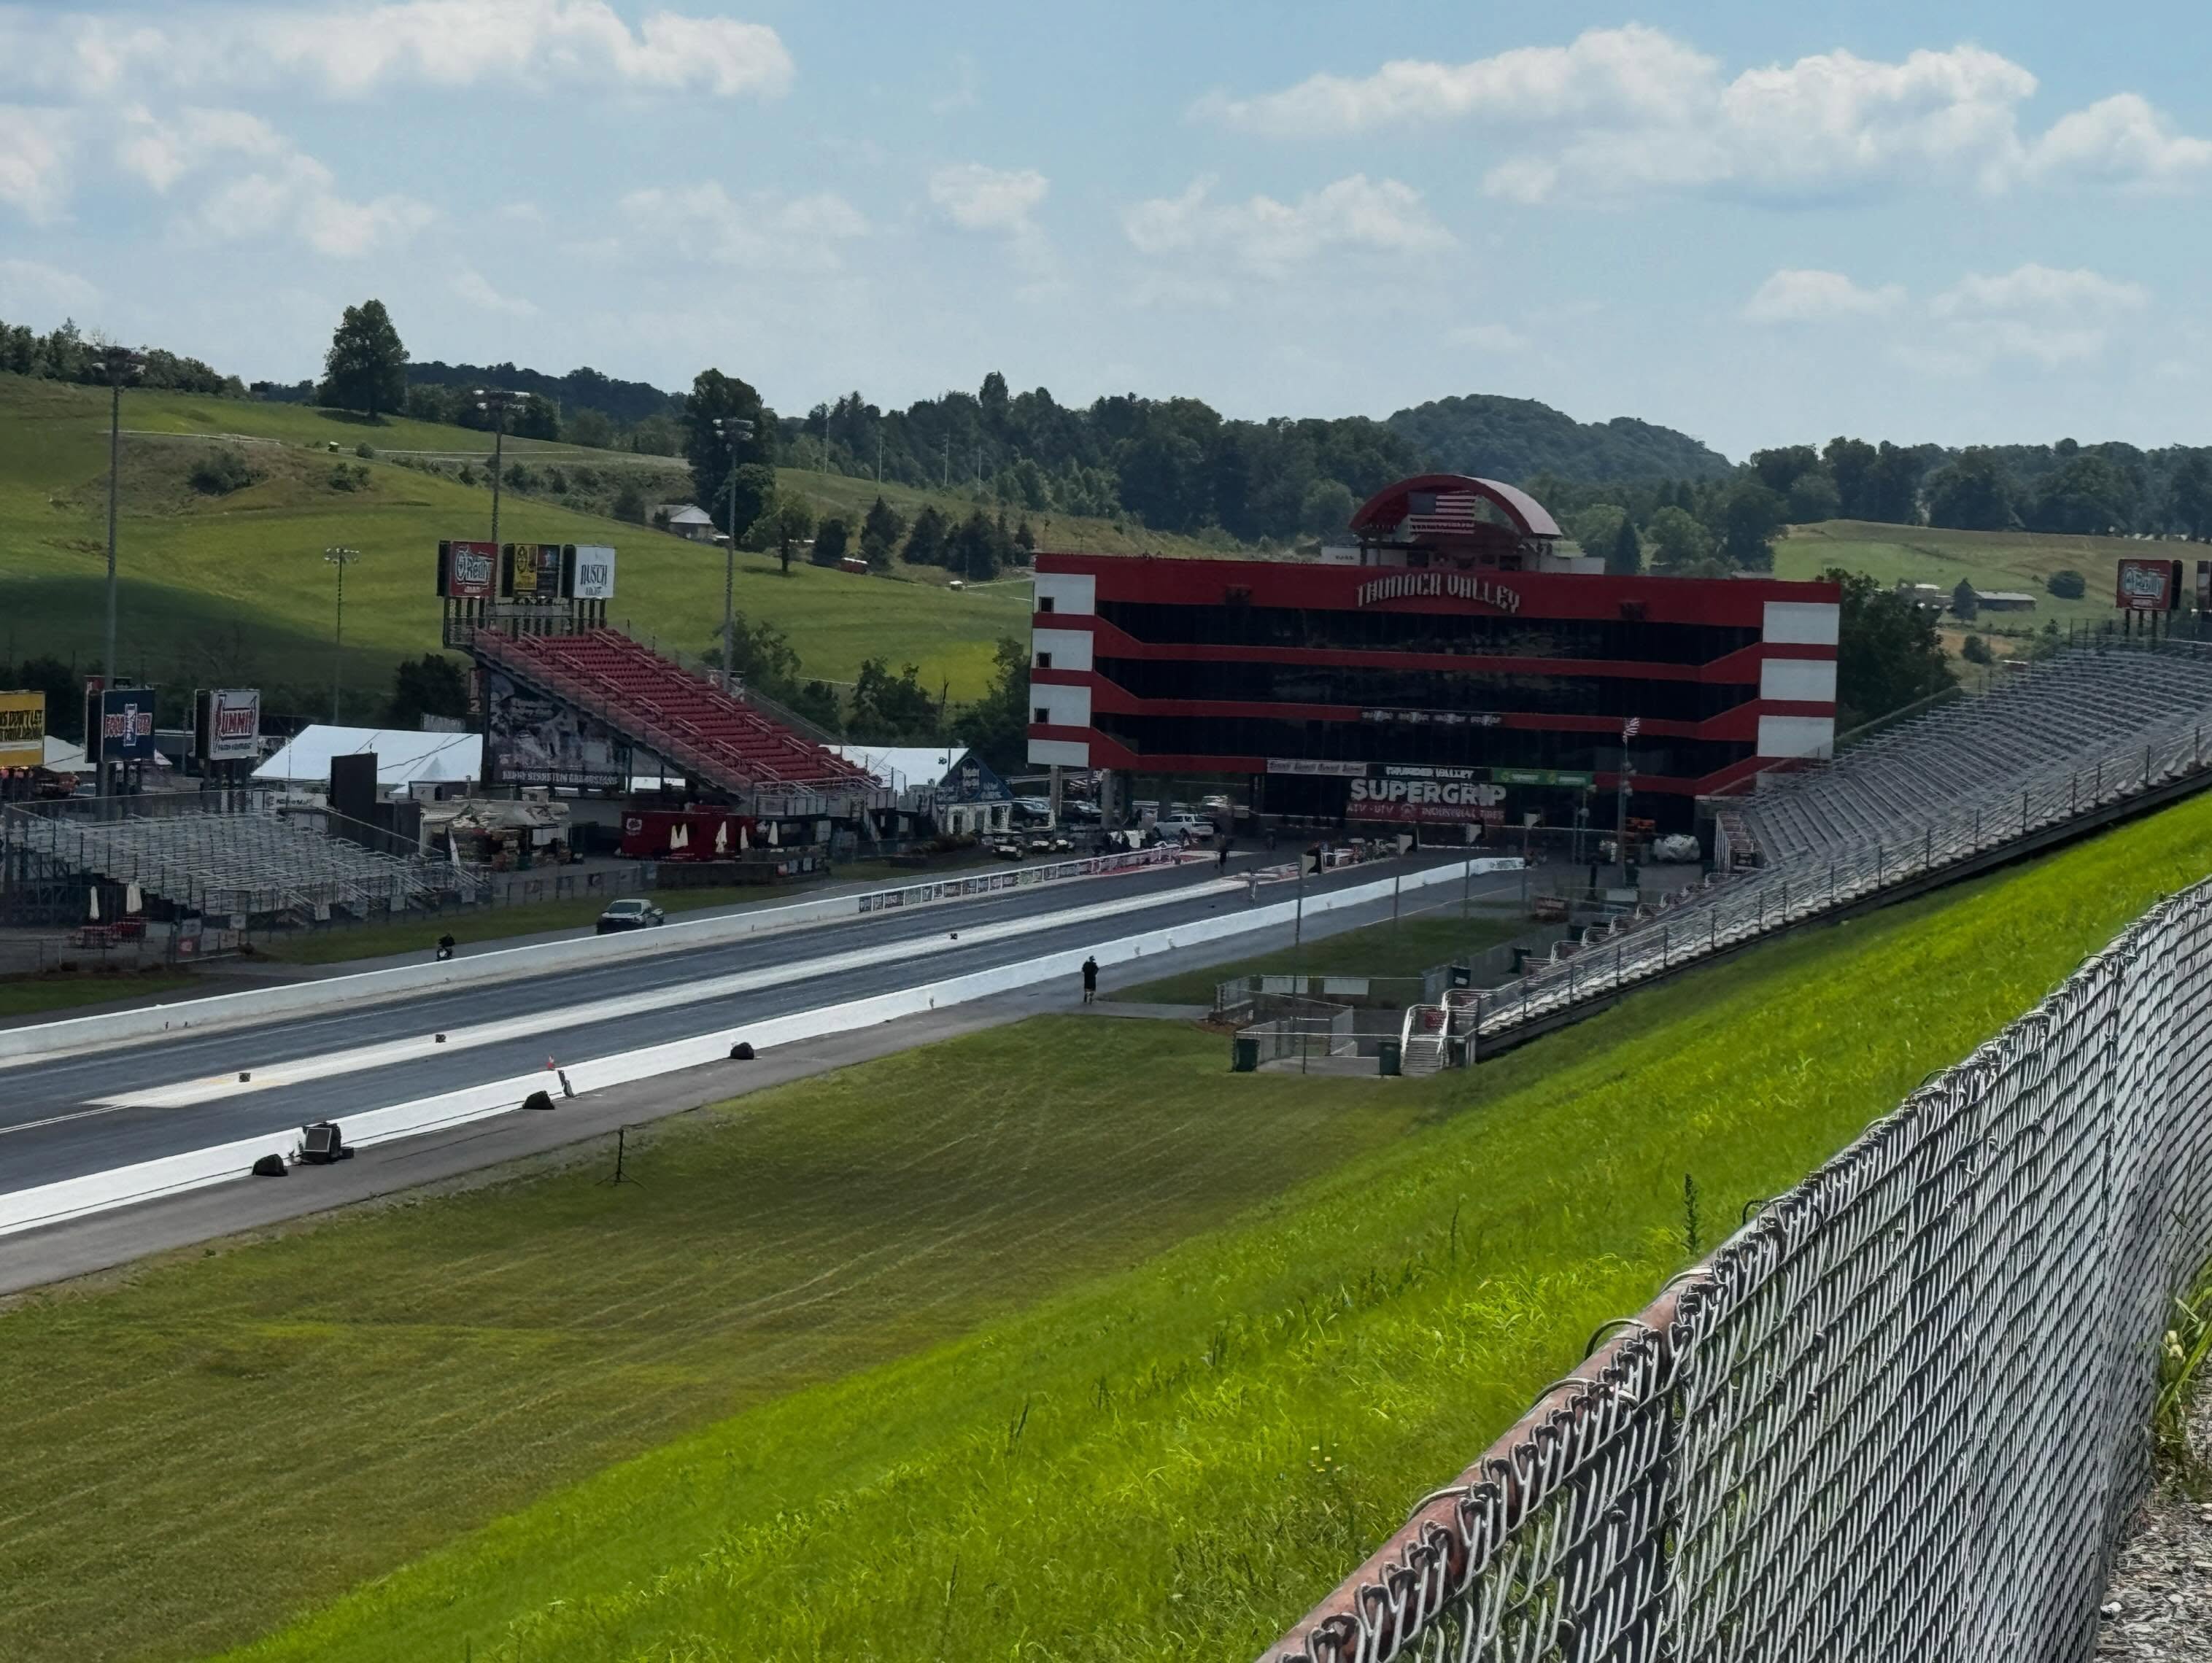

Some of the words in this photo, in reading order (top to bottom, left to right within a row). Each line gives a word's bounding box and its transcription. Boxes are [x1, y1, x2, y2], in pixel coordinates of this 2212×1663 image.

[1357, 573, 1441, 607] THUNDER
[1447, 574, 1520, 613] VALLEY
[1350, 778, 1507, 806] SUPERGRIP
[1346, 803, 1366, 813] ATV
